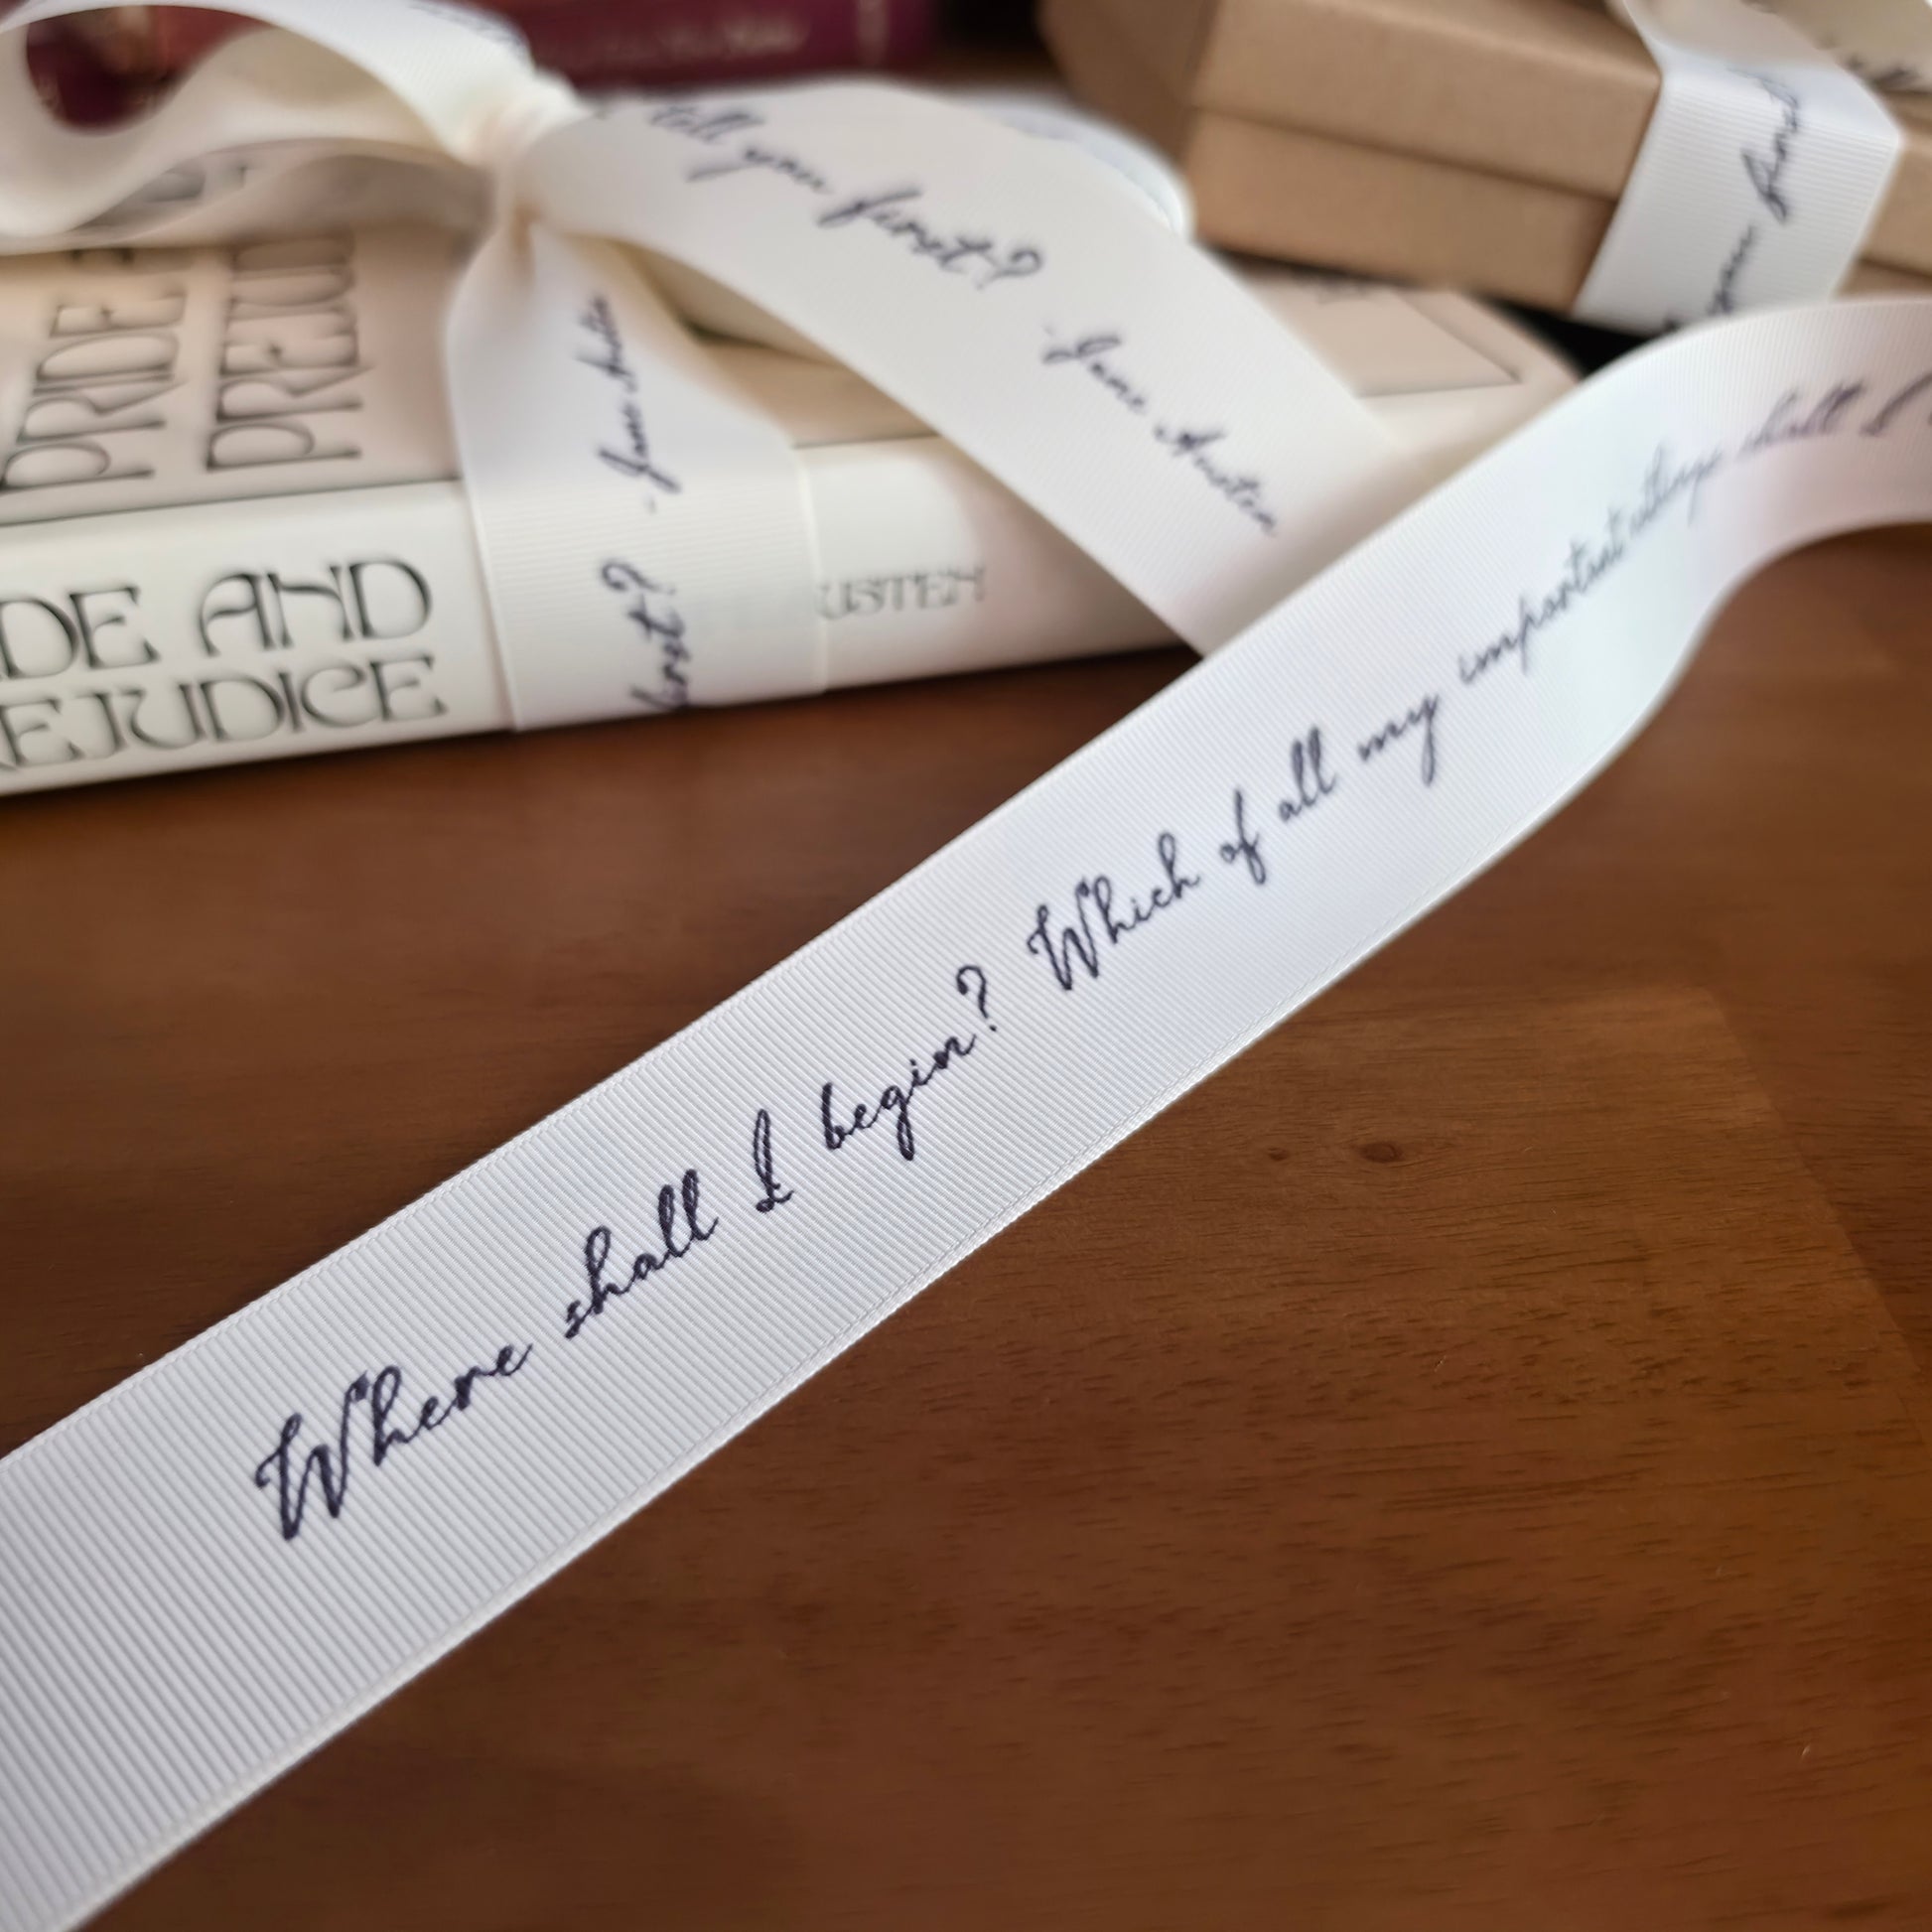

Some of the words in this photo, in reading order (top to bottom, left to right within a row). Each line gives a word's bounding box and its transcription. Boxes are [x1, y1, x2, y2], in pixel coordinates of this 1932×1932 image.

[814, 186, 1045, 291] first?
[0, 286, 189, 493] PRIDE
[199, 558, 433, 658] AND
[0, 655, 449, 772] EJUDICE
[254, 1343, 533, 1541] Where
[564, 1169, 720, 1340] shall
[754, 1108, 794, 1213] I
[822, 965, 997, 1162] begin?
[1026, 831, 1202, 991] Which
[1219, 789, 1267, 886] of
[1278, 725, 1337, 823] all
[1357, 694, 1439, 787] my
